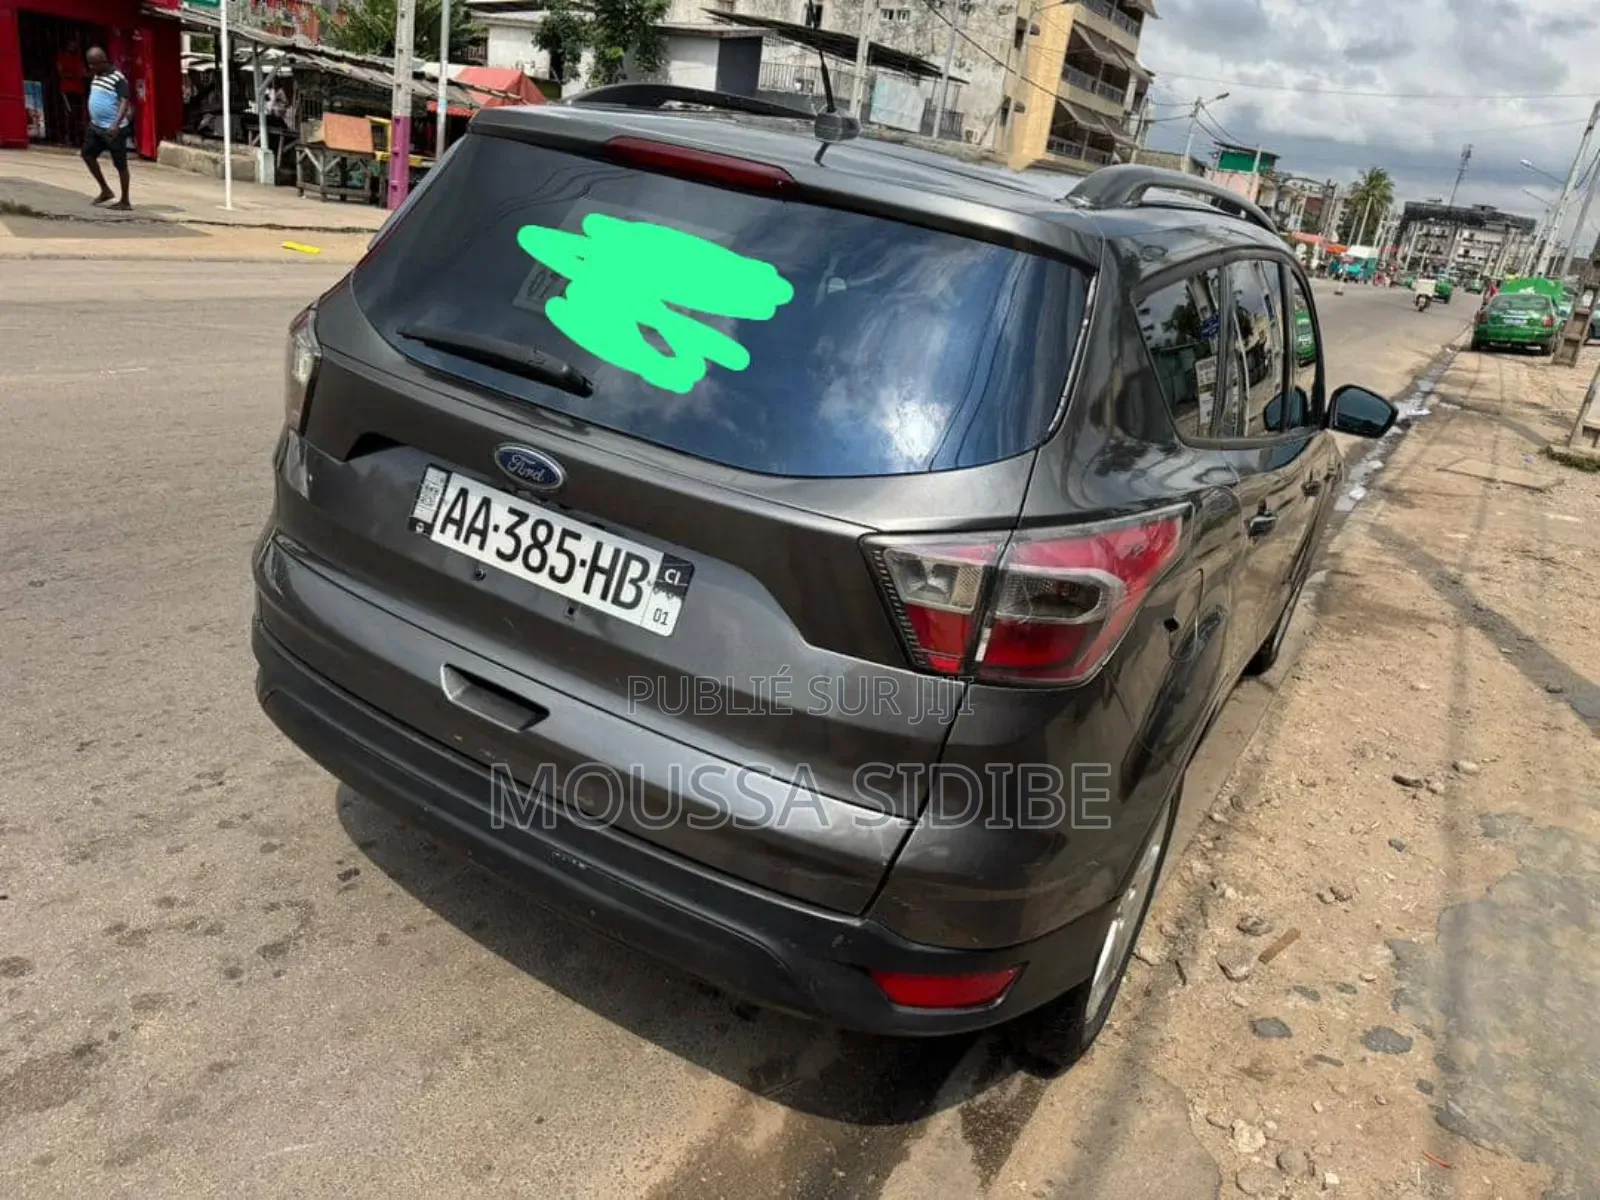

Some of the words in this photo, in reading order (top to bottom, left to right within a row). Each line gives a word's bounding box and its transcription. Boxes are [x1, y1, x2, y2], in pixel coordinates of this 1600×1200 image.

[507, 454, 546, 482] Ford
[664, 568, 682, 586] CI
[652, 607, 669, 626] 01
